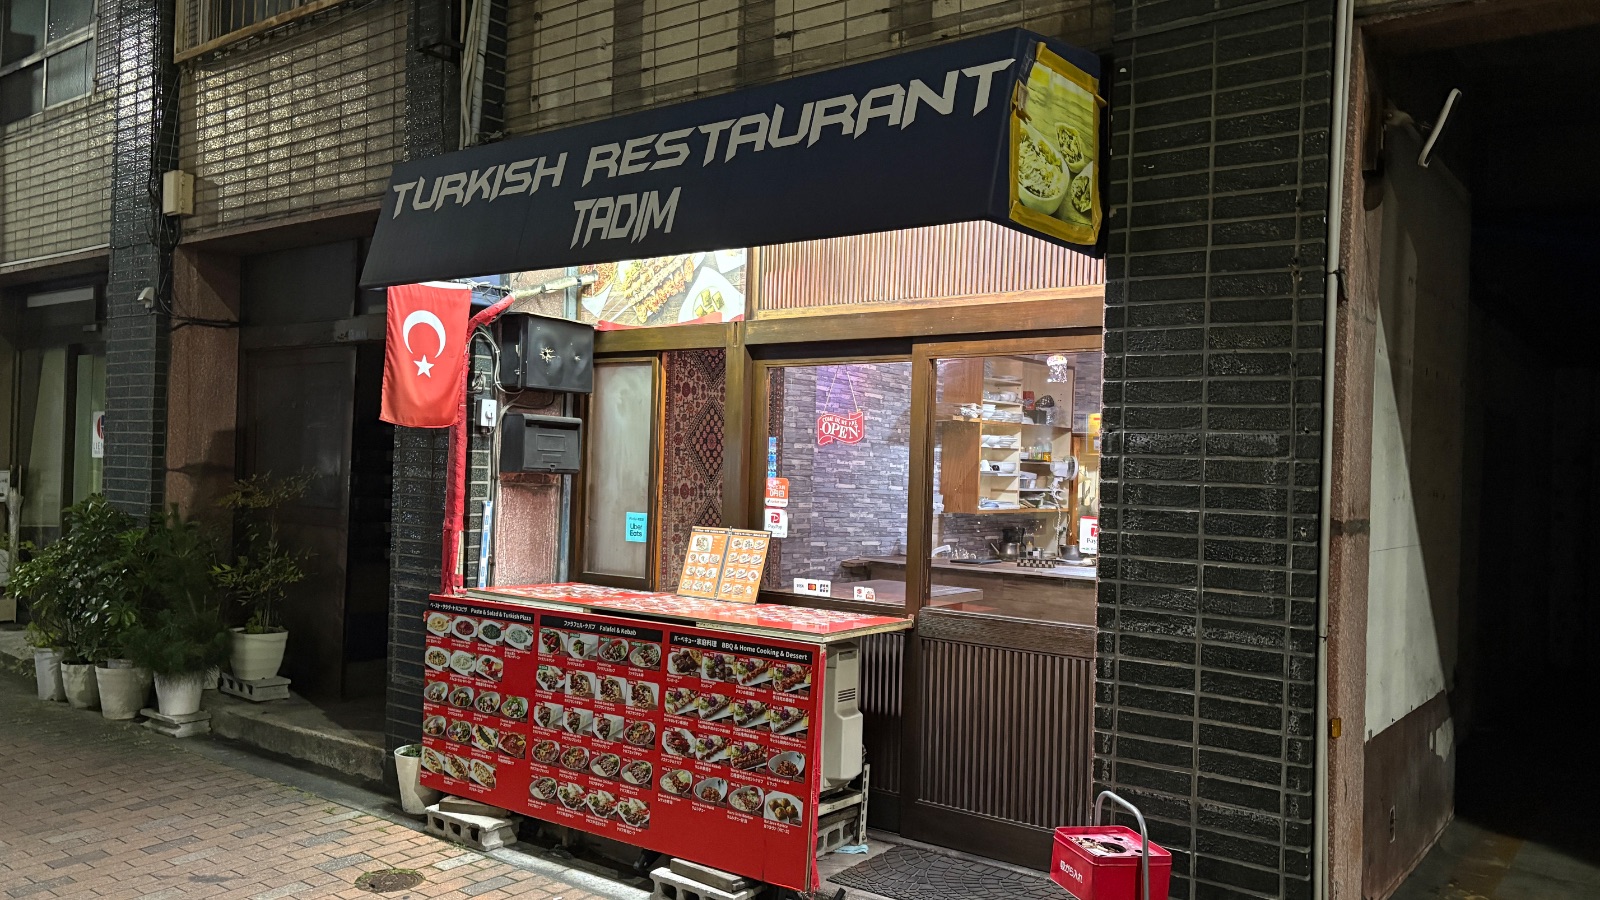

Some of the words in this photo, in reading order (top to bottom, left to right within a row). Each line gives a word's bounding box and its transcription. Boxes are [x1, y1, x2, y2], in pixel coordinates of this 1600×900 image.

[392, 150, 568, 221] TURKISH
[581, 57, 1017, 188] RESTAURANT
[571, 186, 682, 251] TADIM
[822, 422, 858, 439] OPEN
[600, 625, 616, 633] Falafel
[721, 642, 734, 651] BBQ
[739, 644, 756, 653] Home
[756, 646, 779, 658] Cooking
[785, 650, 808, 661] Dessert
